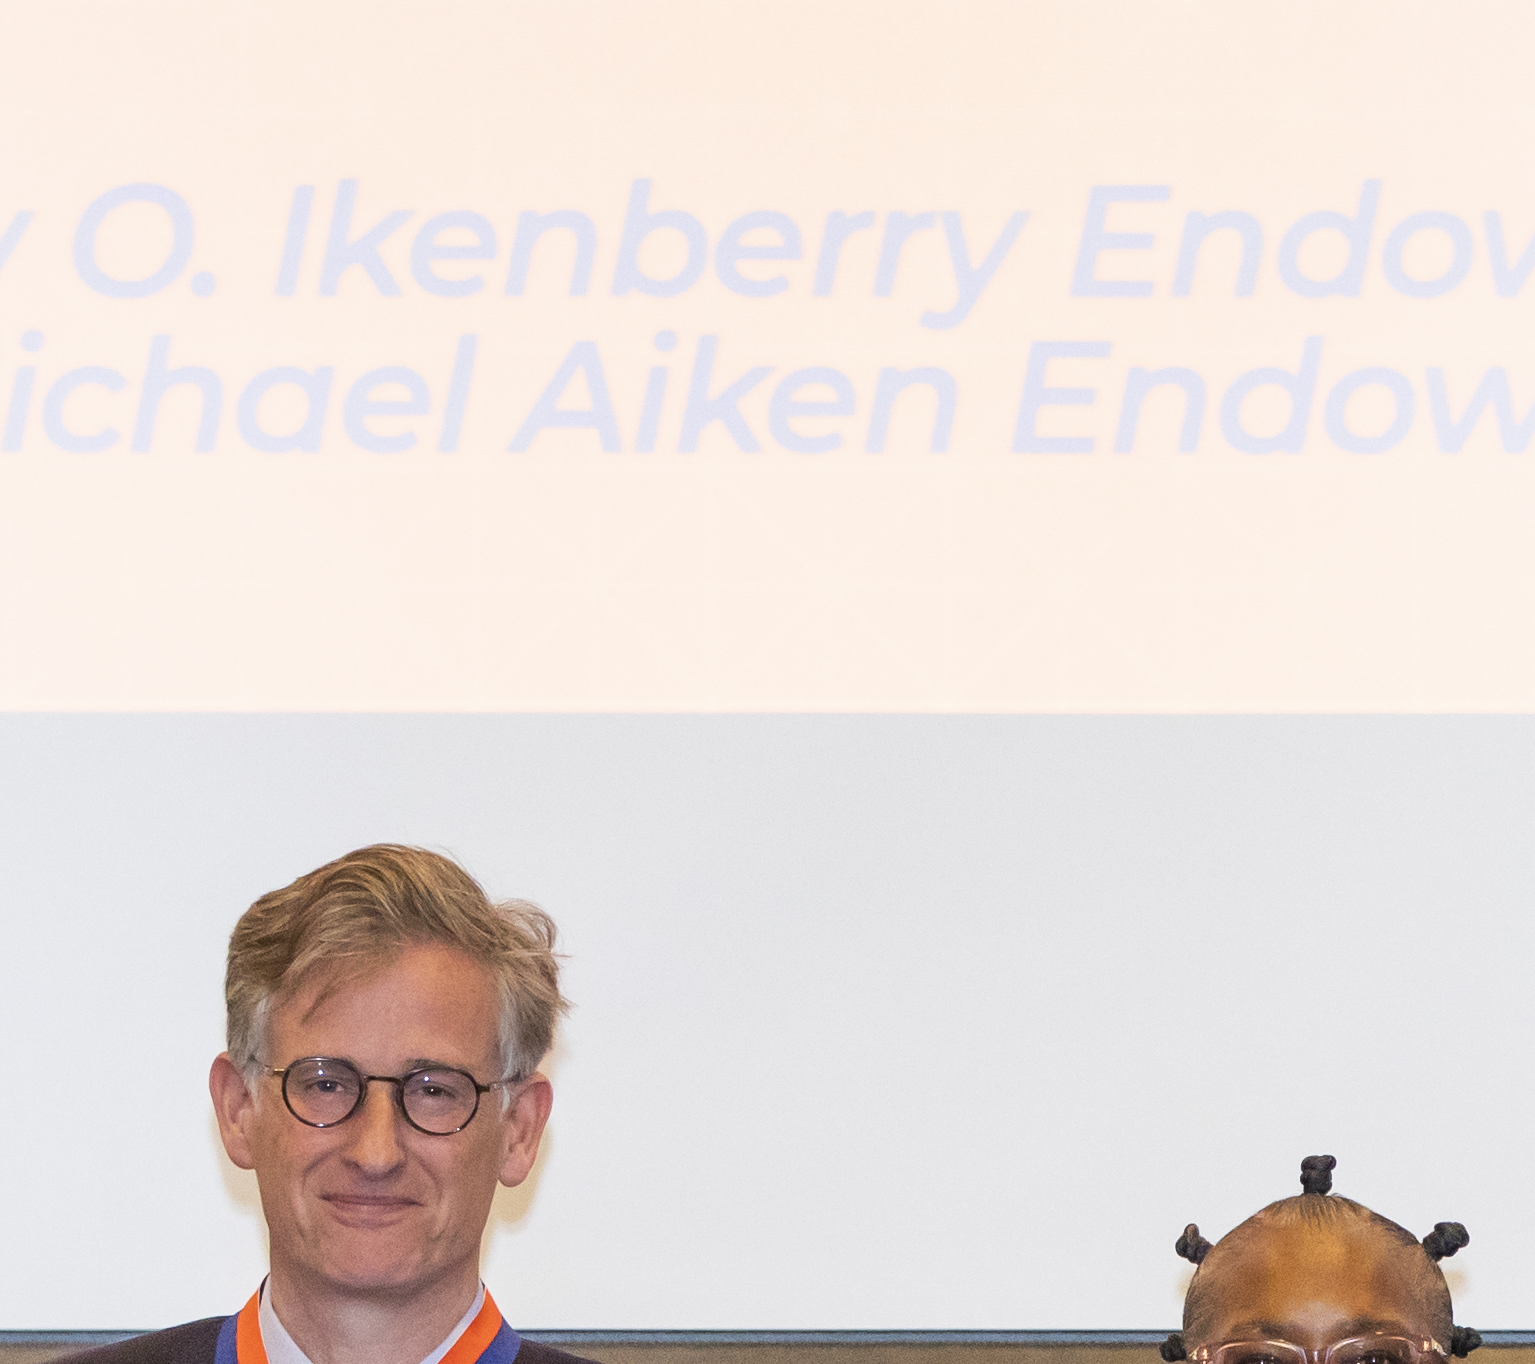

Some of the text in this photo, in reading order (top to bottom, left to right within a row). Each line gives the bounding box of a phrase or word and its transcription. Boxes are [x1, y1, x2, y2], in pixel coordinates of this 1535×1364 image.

[69, 180, 218, 301] O.
[272, 174, 1033, 334] Ikenberry
[504, 327, 960, 457] Aiken
